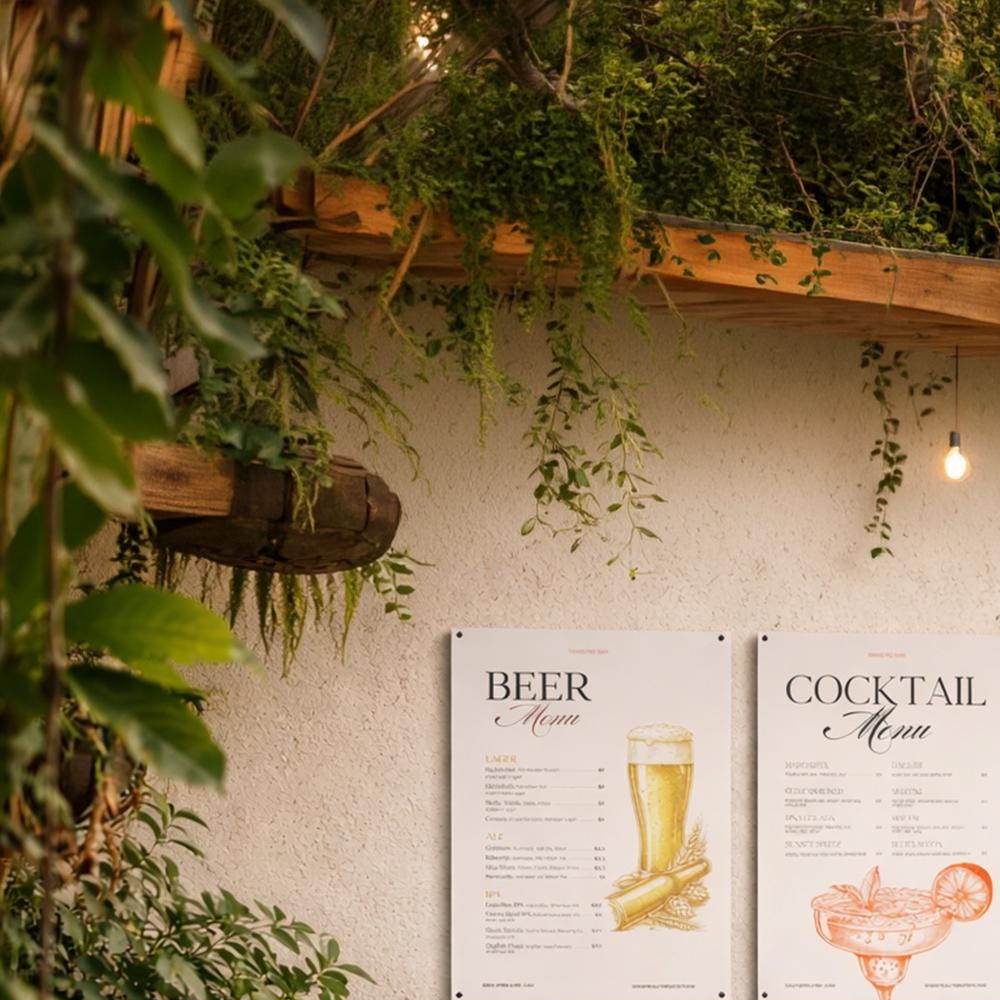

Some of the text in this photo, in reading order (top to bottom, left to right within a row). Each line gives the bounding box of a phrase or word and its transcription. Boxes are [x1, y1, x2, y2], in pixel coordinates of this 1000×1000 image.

[485, 671, 592, 702] BEER
[785, 674, 987, 706] COCKTAIL
[494, 703, 581, 738] Menu
[822, 704, 932, 755] Menu
[484, 754, 518, 764] LAGER
